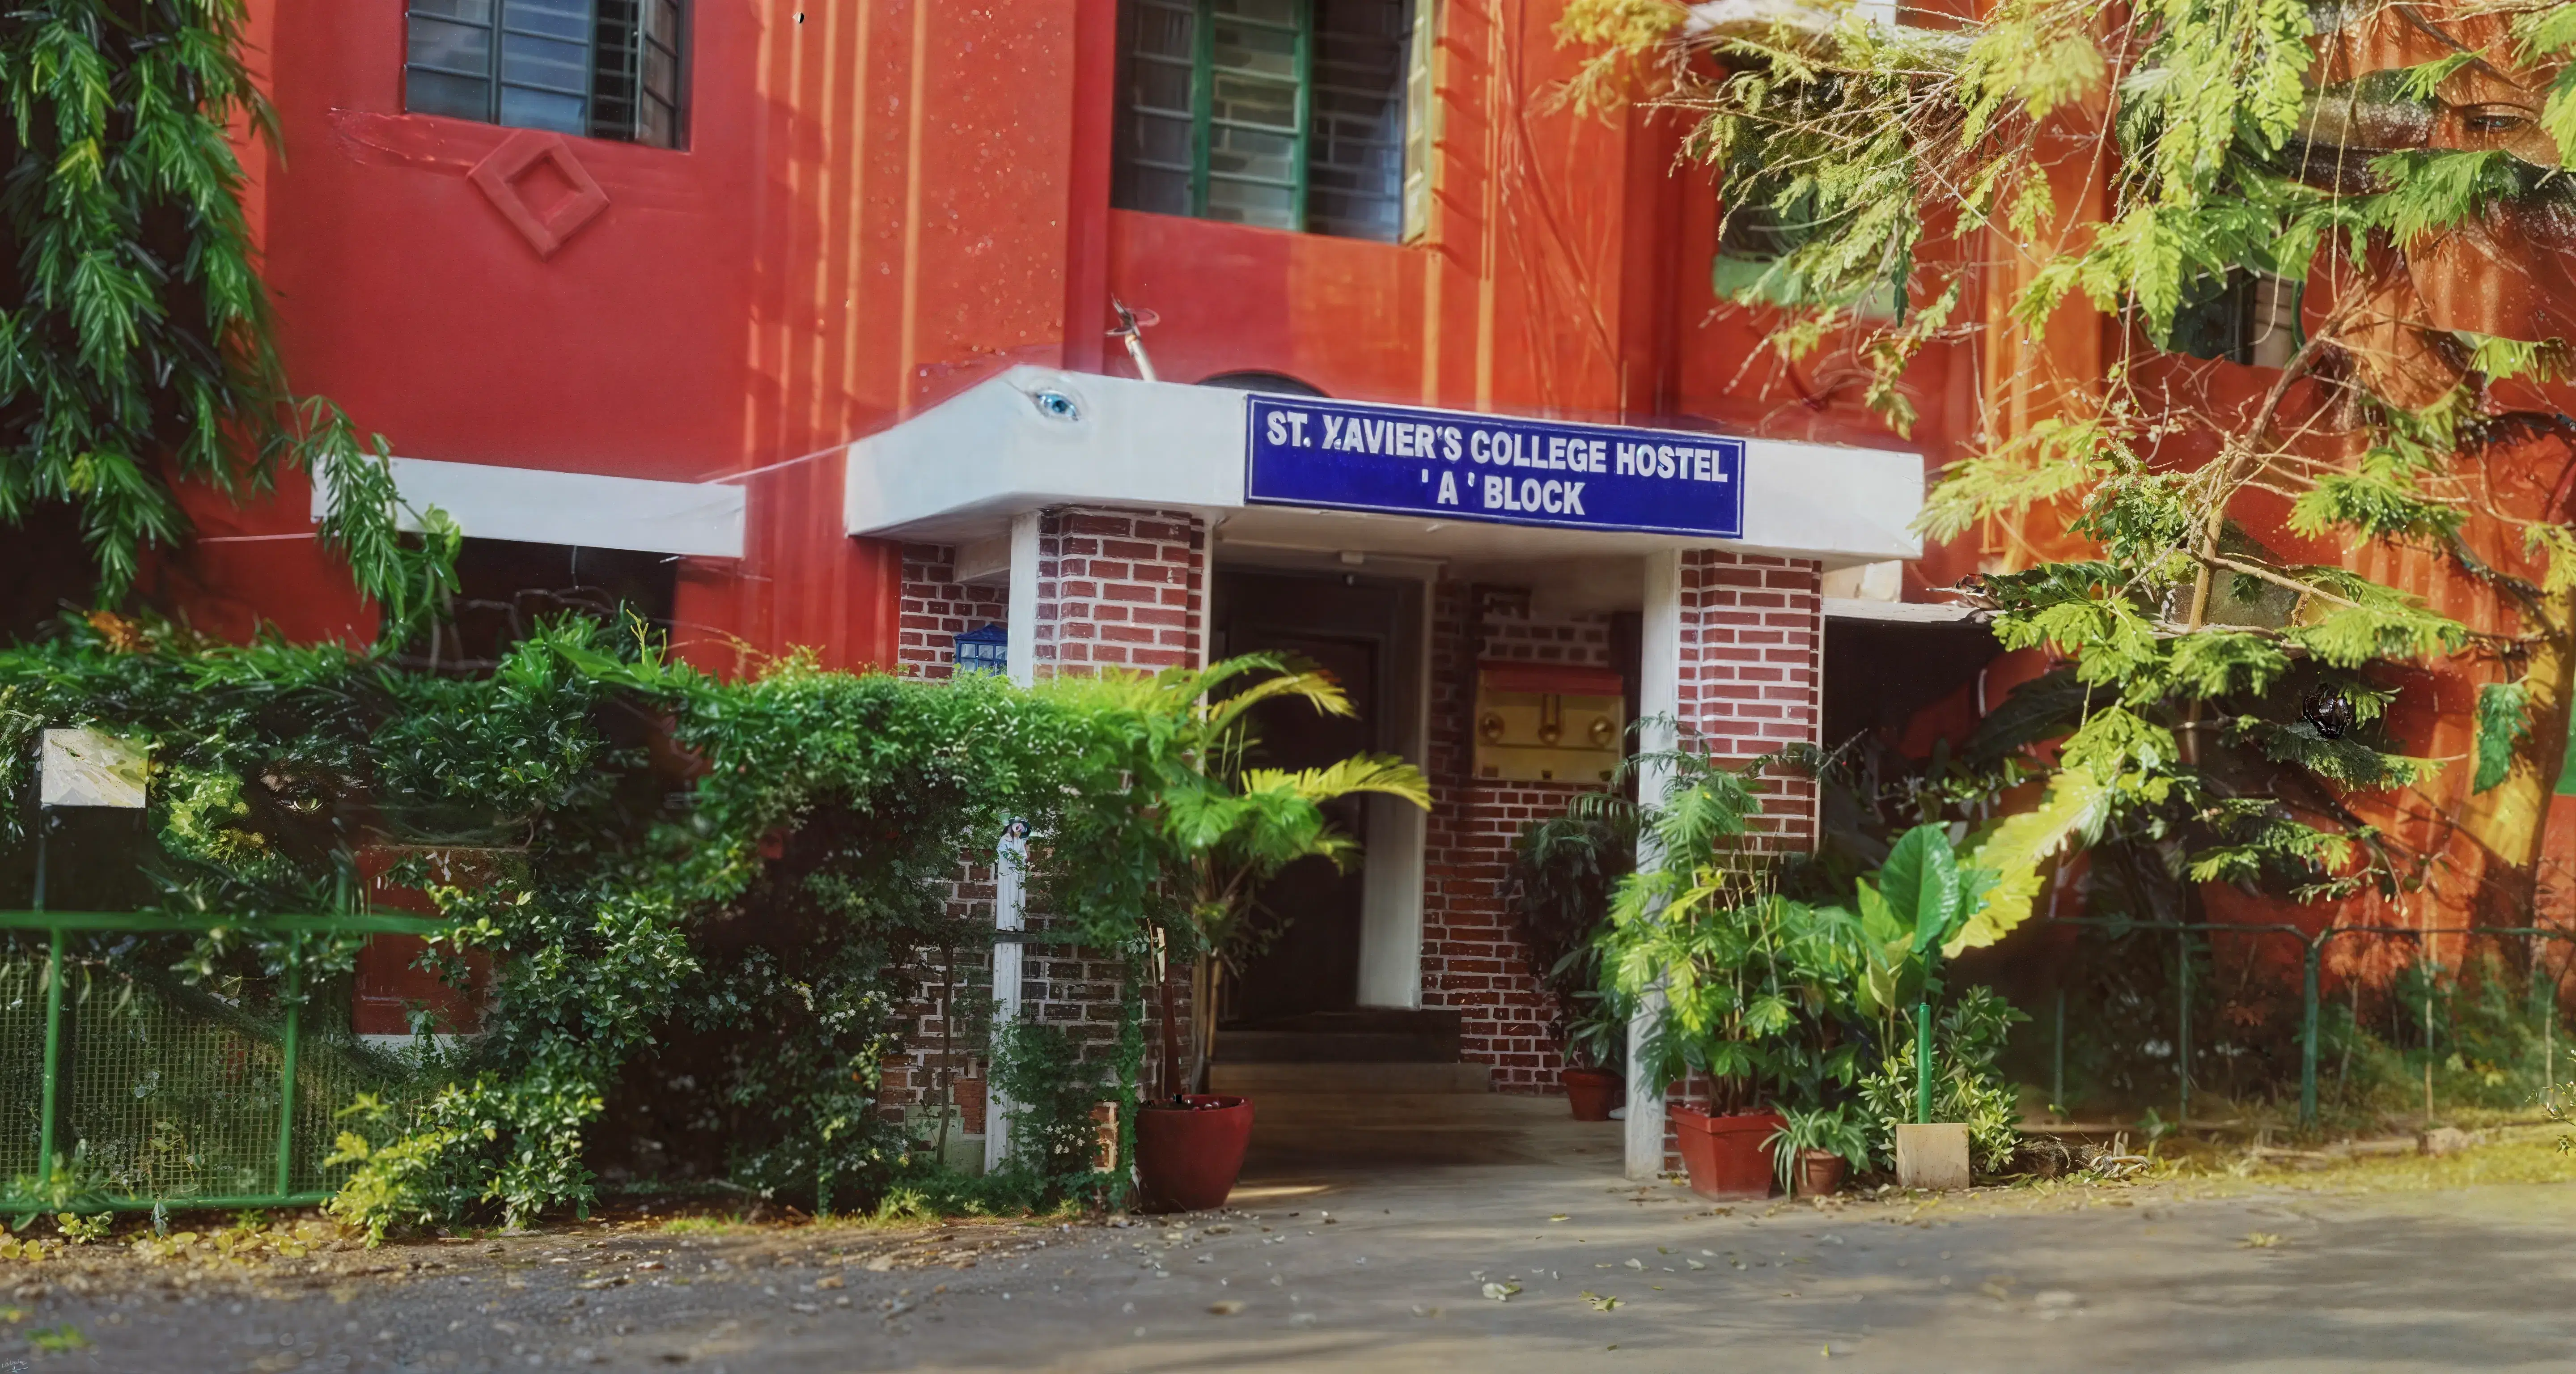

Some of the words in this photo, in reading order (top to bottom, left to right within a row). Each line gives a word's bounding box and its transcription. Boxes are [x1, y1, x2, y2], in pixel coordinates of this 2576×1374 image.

[1267, 411, 1311, 447] ST.
[1322, 414, 1462, 464] XAVIER'S
[1470, 430, 1606, 473] COLLEGE
[1616, 442, 1728, 483] HOSTEL
[1484, 475, 1585, 515] BLOCK
